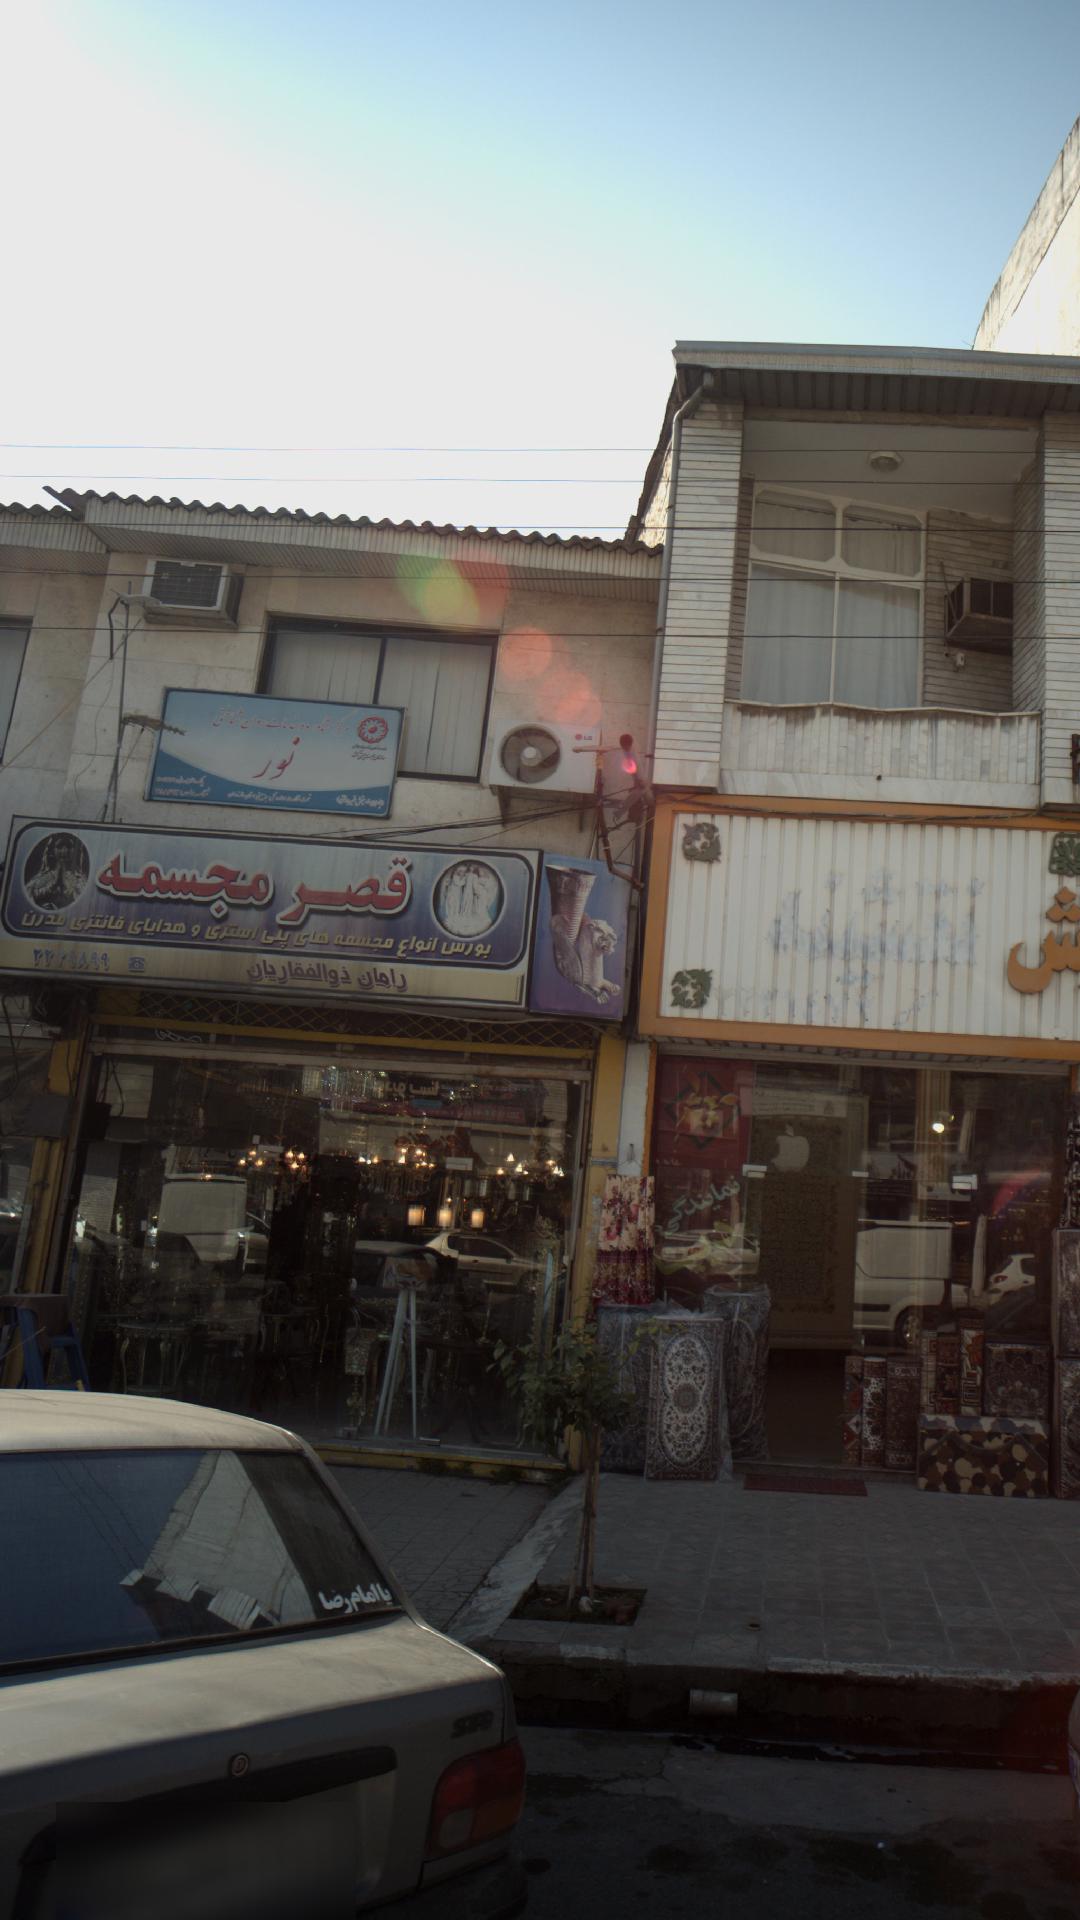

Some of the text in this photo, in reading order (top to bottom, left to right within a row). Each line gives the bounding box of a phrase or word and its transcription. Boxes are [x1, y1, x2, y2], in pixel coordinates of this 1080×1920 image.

[252, 737, 300, 780] نور
[95, 848, 412, 926] قصر مجسمه
[21, 910, 491, 959] بورس انواع مجسمه های پلی استری و هدایای فانتزی مدرن
[318, 1589, 353, 1614] رضا
[351, 1583, 380, 1612] امام
